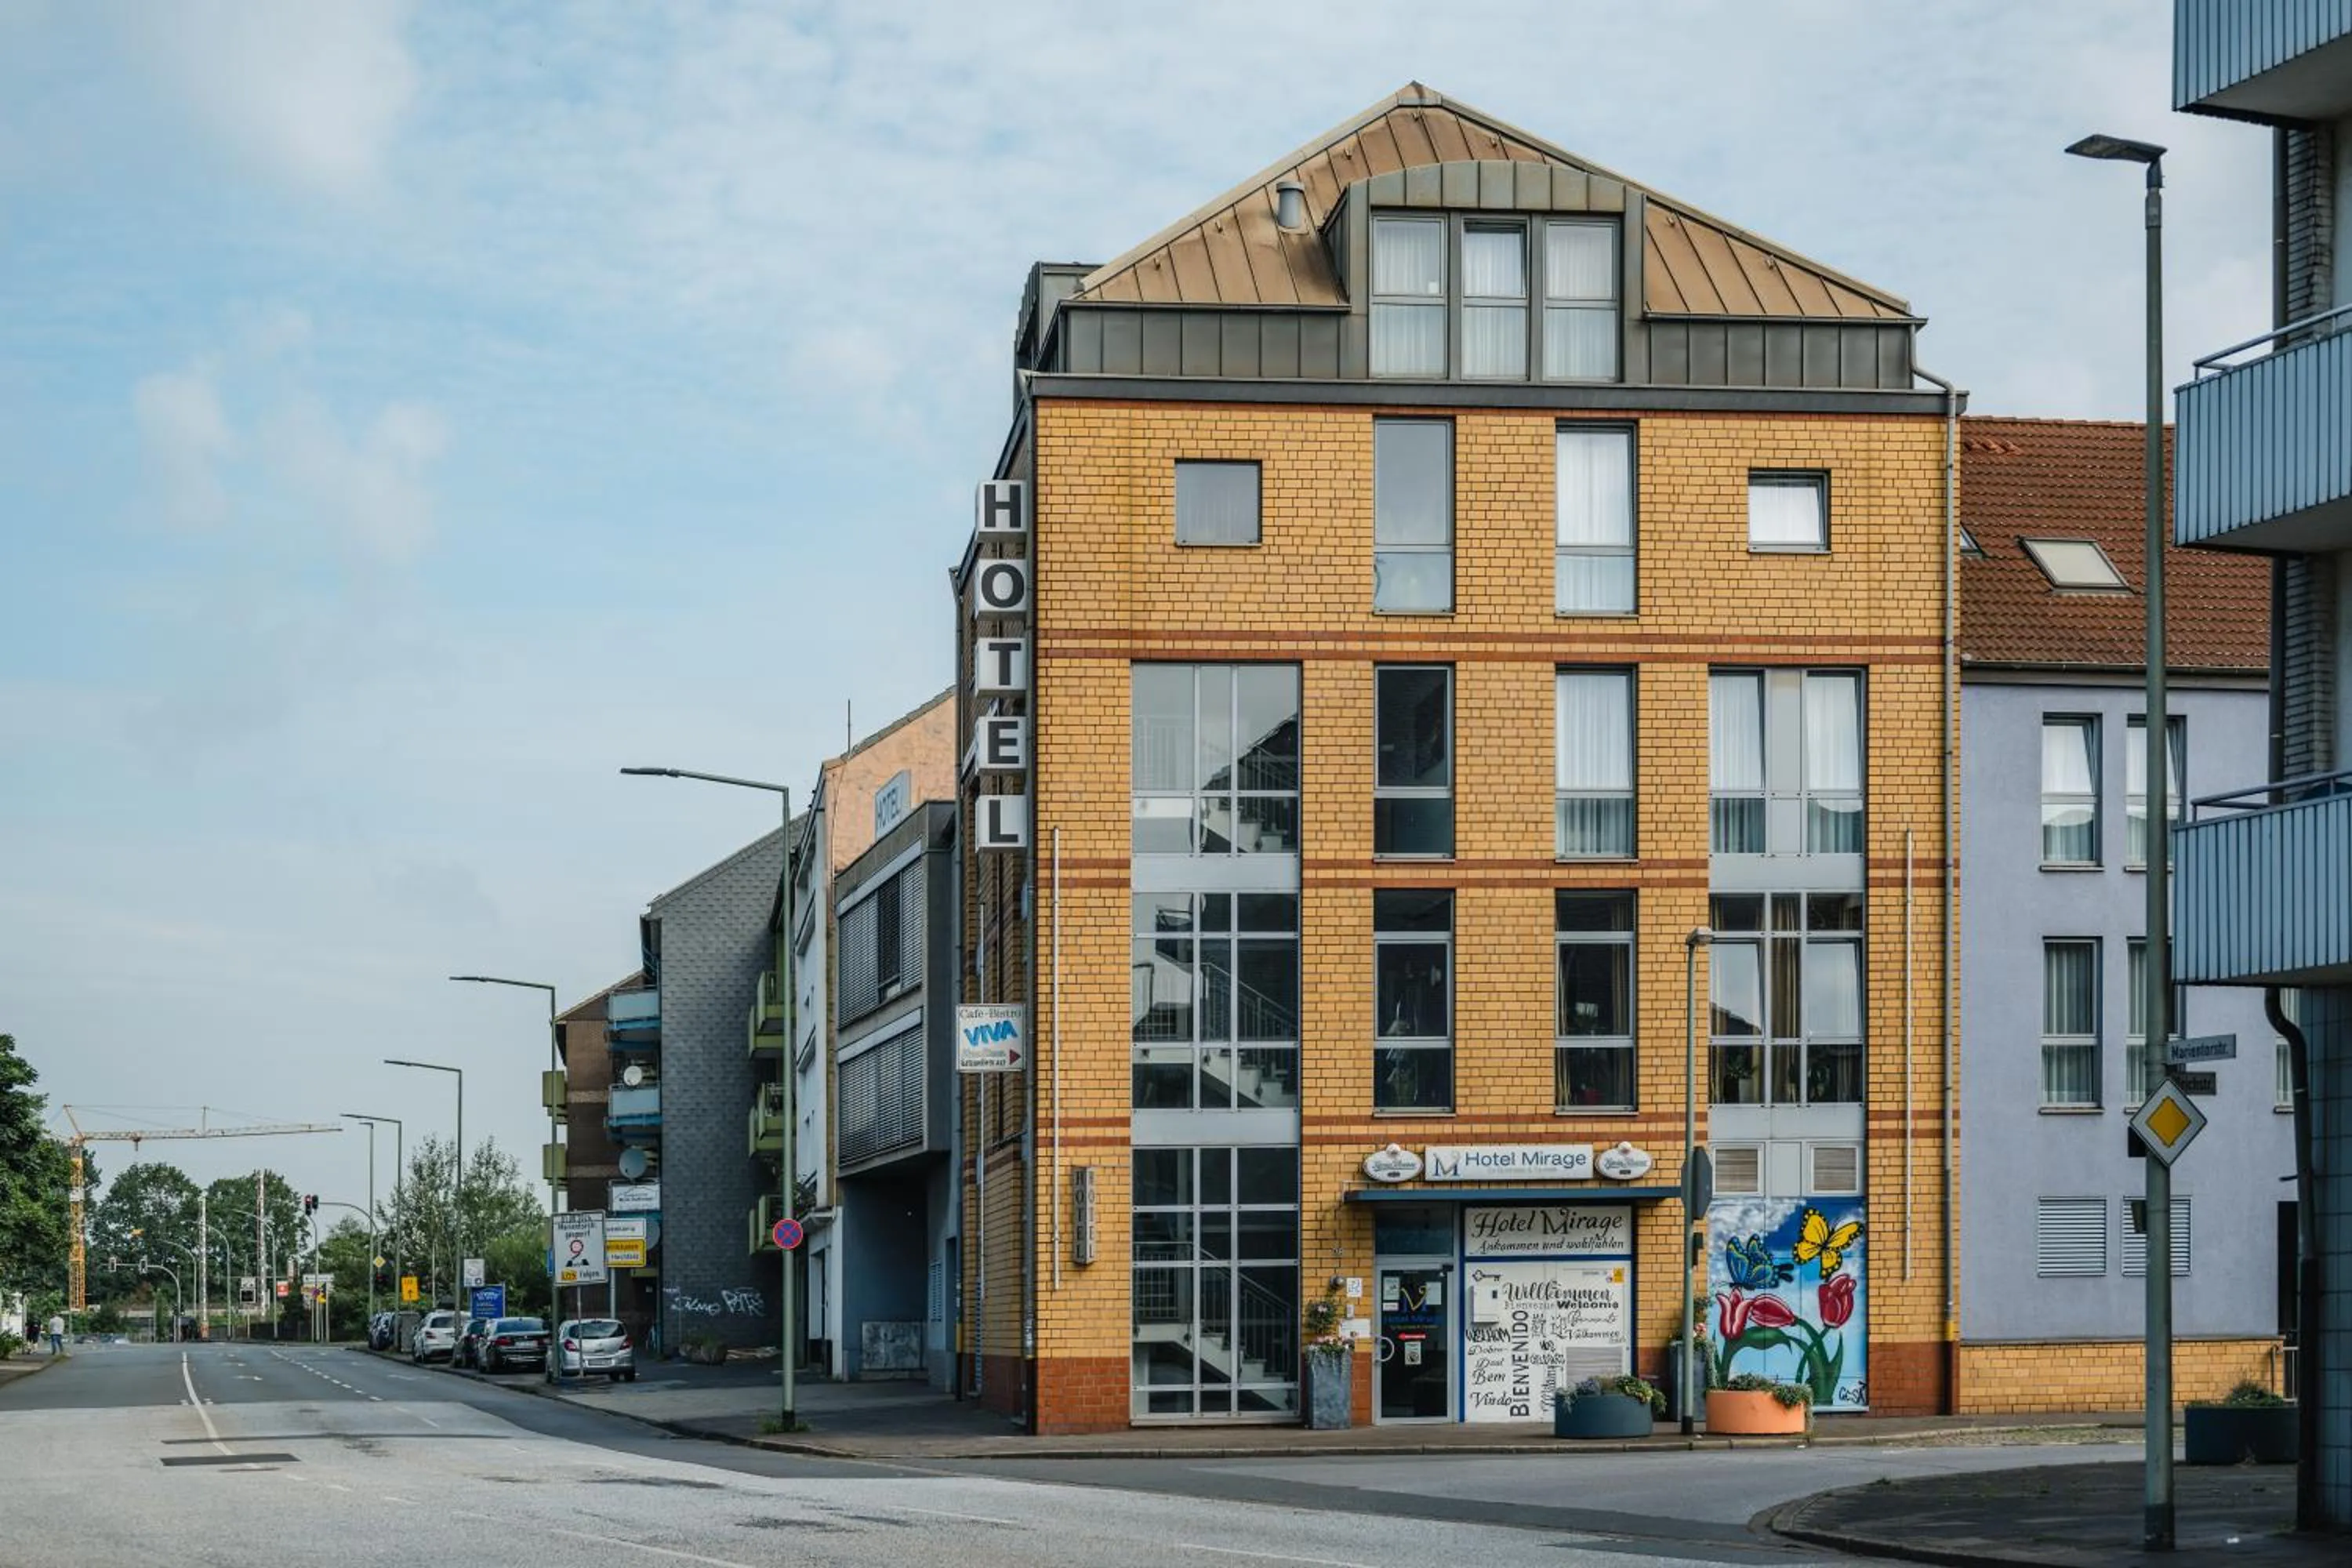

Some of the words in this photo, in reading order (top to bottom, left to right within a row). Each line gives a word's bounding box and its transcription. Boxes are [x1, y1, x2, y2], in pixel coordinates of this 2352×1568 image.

[981, 484, 1024, 844] HOTEL
[964, 1020, 1018, 1046] VIVA
[1465, 1152, 1515, 1166] Hotel
[1522, 1151, 1586, 1169] Mirage
[1076, 1171, 1085, 1258] HOTEL
[1471, 1210, 1535, 1238] Hotel
[1540, 1207, 1622, 1237] Mirage
[1542, 1237, 1565, 1250] und
[1502, 1279, 1615, 1302] Willkommen
[1556, 1300, 1619, 1309] Welcome
[1510, 1310, 1530, 1417] BIENVENIDO
